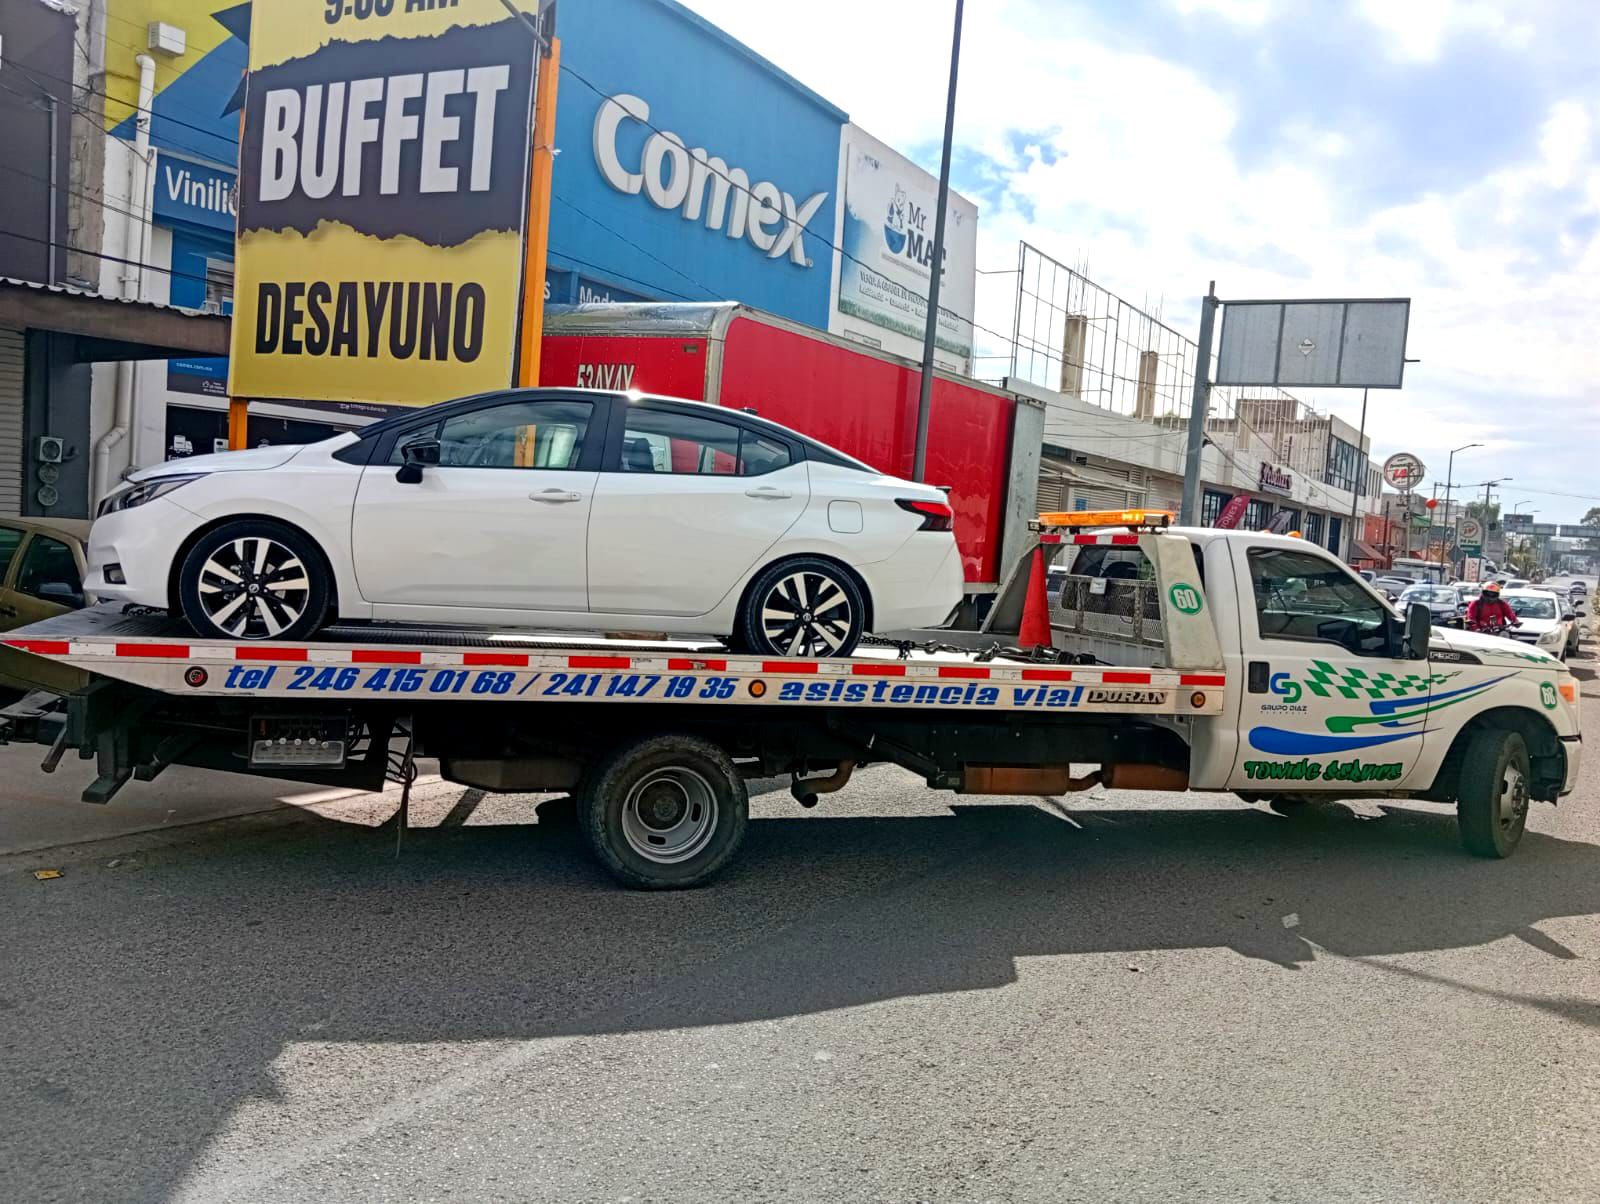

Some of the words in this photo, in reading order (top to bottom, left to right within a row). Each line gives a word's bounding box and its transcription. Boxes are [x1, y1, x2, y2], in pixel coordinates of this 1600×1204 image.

[259, 65, 510, 202] BUFFET
[593, 93, 830, 266] Comex
[908, 201, 927, 232] Mr
[254, 280, 487, 364] DESAYUNO
[224, 665, 278, 690] tel
[286, 666, 361, 691] 246
[363, 668, 428, 692] 415
[429, 669, 470, 694] 01
[471, 671, 517, 695] 68
[516, 673, 542, 695] /
[542, 673, 603, 697] 241
[605, 674, 662, 697] 147
[663, 676, 697, 698] 19
[698, 677, 740, 699] 35
[778, 679, 1001, 705] asistencia
[1013, 684, 1085, 708] vial
[1088, 689, 1168, 705] DURAN
